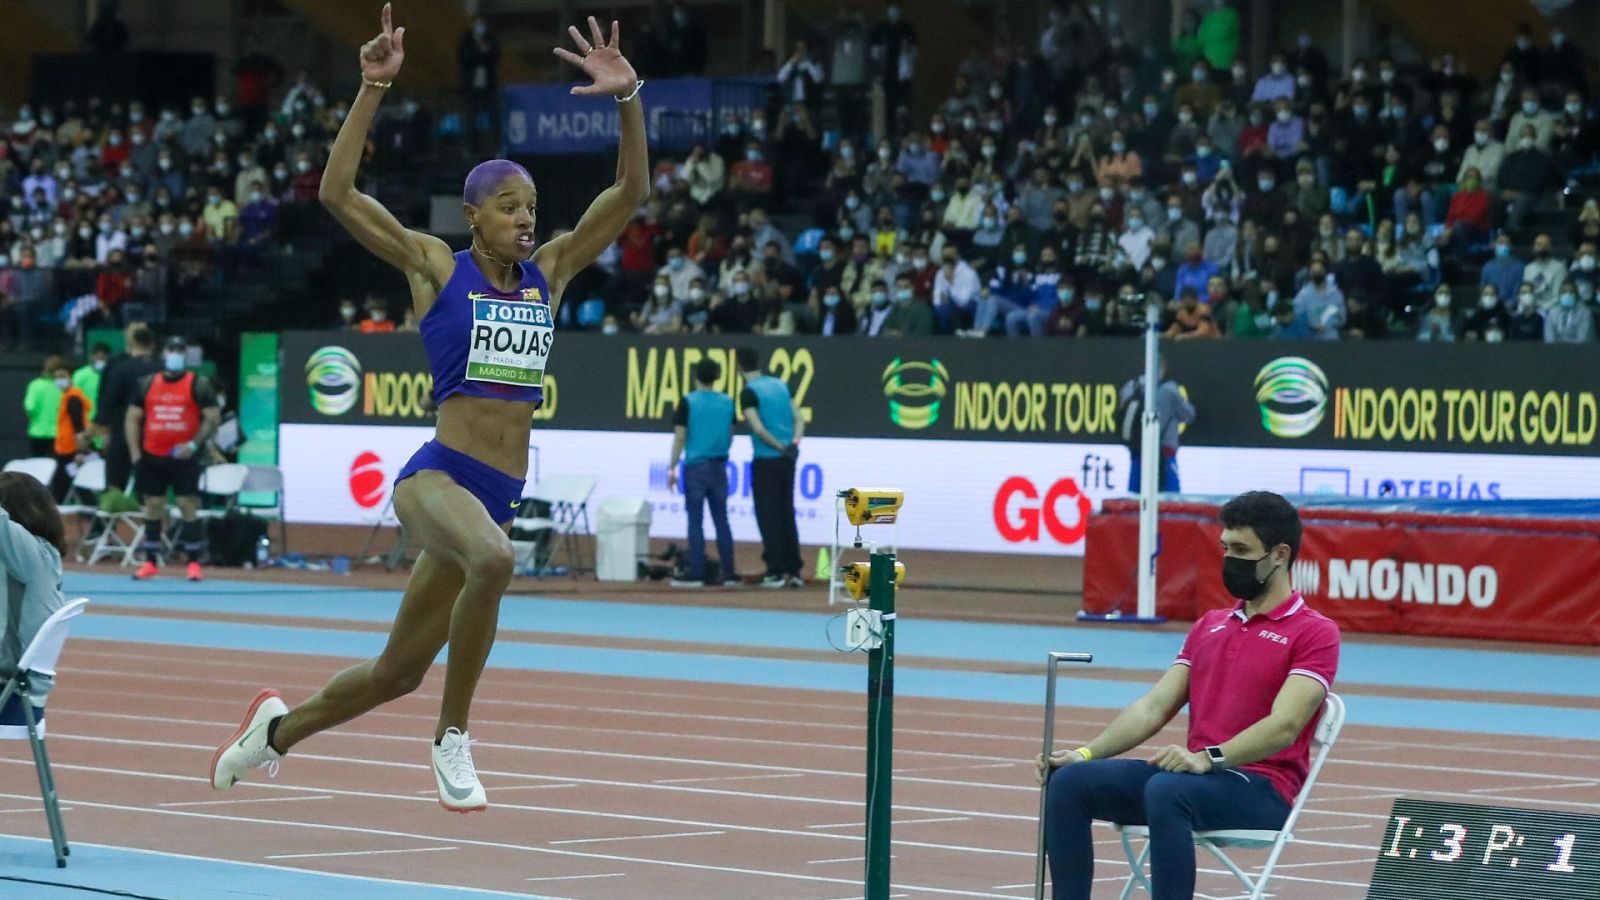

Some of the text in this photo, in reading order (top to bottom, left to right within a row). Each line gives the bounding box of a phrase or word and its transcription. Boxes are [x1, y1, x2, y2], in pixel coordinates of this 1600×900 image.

[487, 304, 546, 323] Joma
[473, 325, 552, 357] ROJAS
[479, 367, 516, 378] MADRID
[493, 356, 521, 365] MADRID
[363, 372, 433, 417] INDOO
[954, 381, 1116, 434] INDOOR TOUR
[1334, 387, 1597, 445] INDOOR TOUR GOLD
[1082, 454, 1114, 490] fit
[993, 475, 1092, 545] GO
[1328, 558, 1498, 608] MONDO
[1258, 629, 1288, 645] RFEA
[1545, 832, 1576, 872] 1
